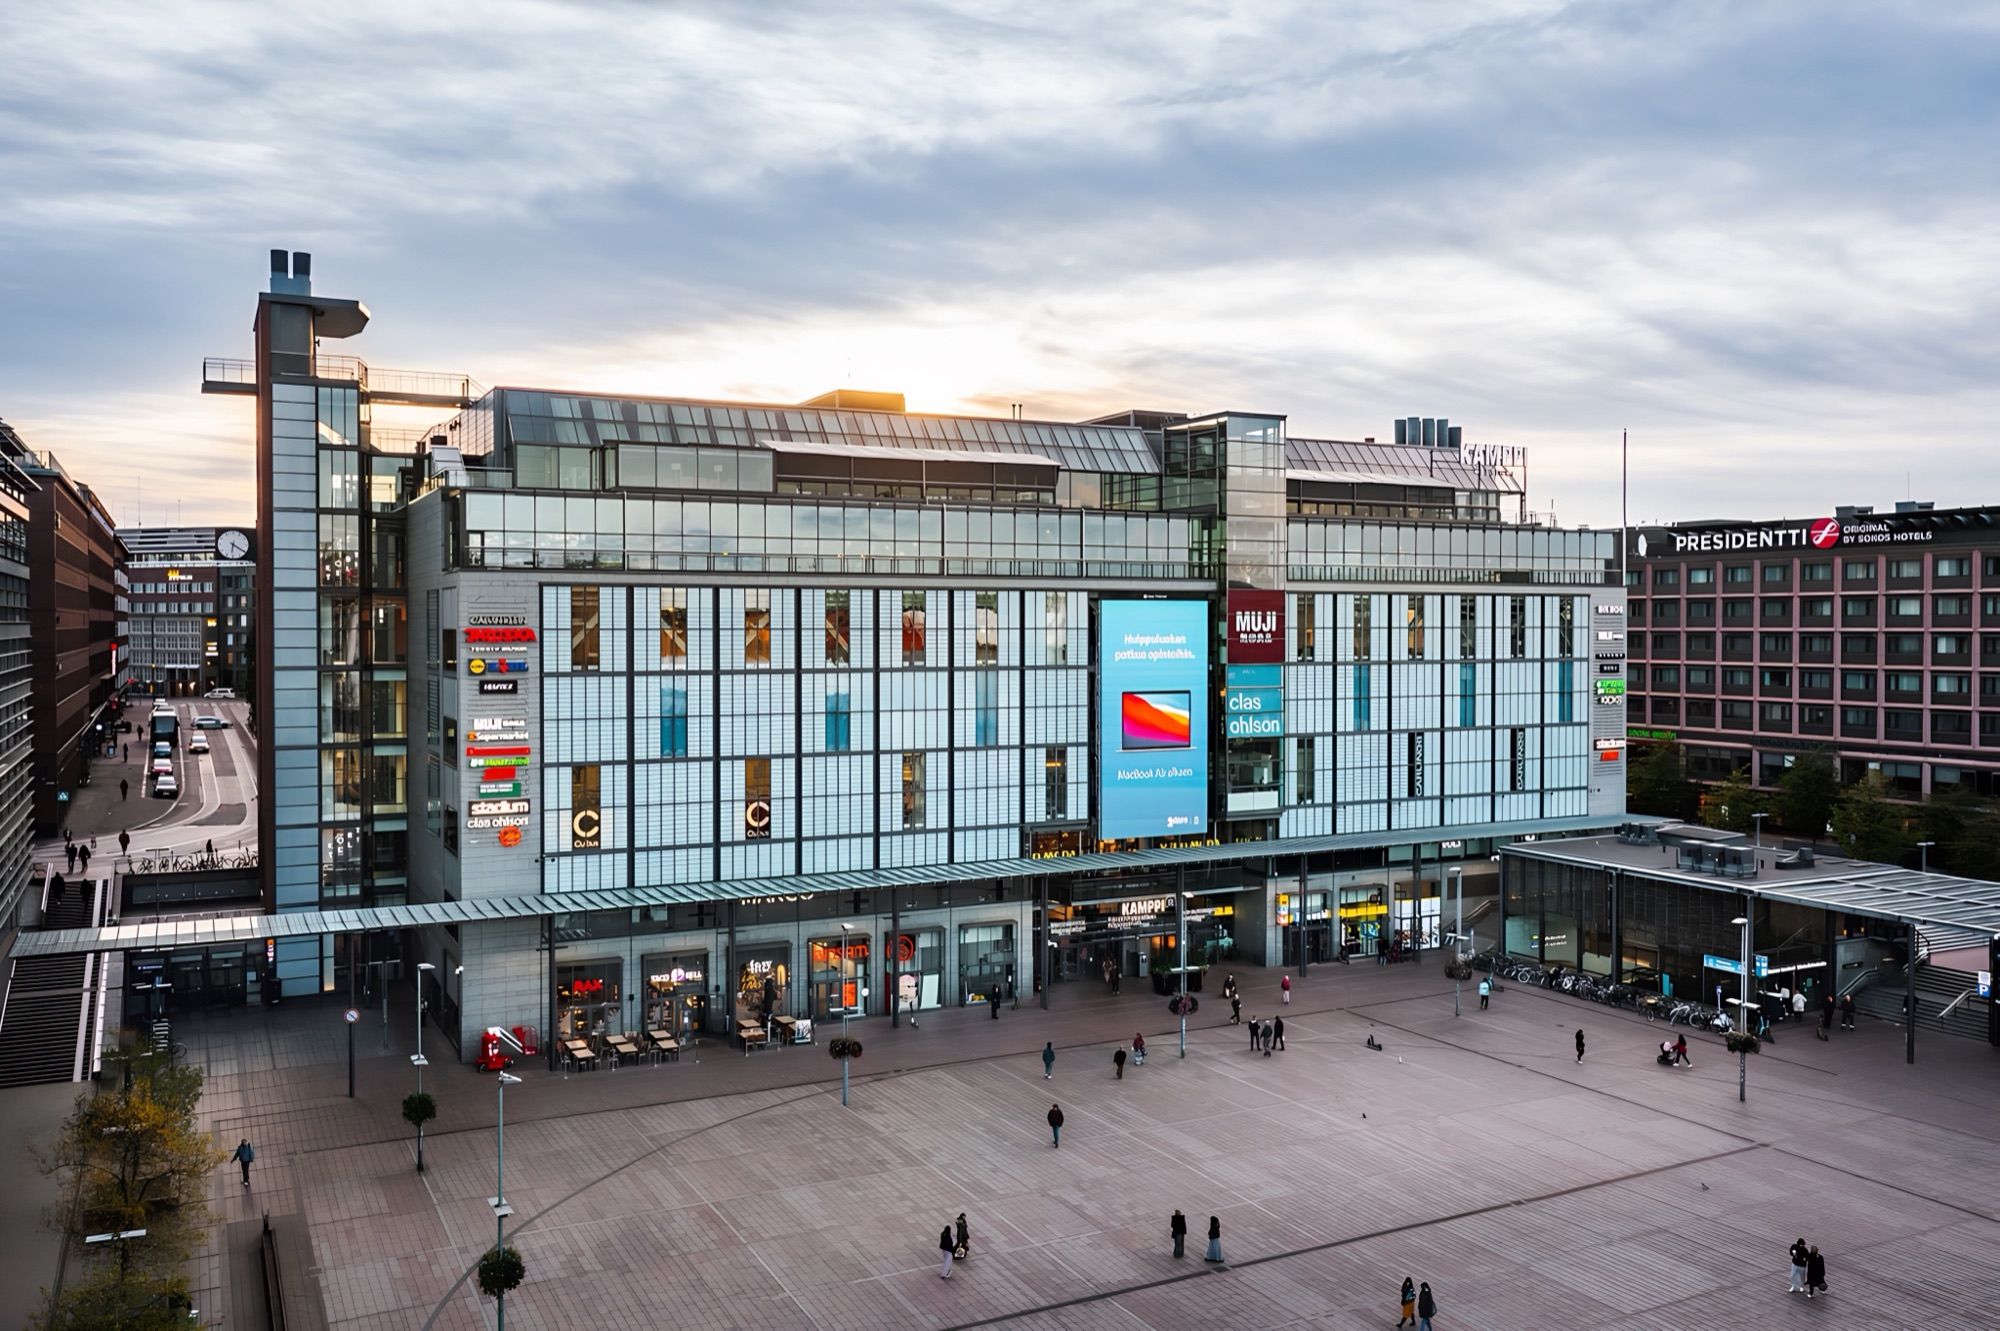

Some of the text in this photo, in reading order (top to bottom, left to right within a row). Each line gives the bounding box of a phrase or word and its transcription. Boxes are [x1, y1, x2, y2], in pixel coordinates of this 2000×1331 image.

[1676, 529, 1807, 551] PRESIDENTTI
[1235, 611, 1277, 632] MUJI
[1229, 692, 1261, 710] clas
[1229, 715, 1280, 734] ohlson
[1121, 899, 1166, 916] KAMPPI
